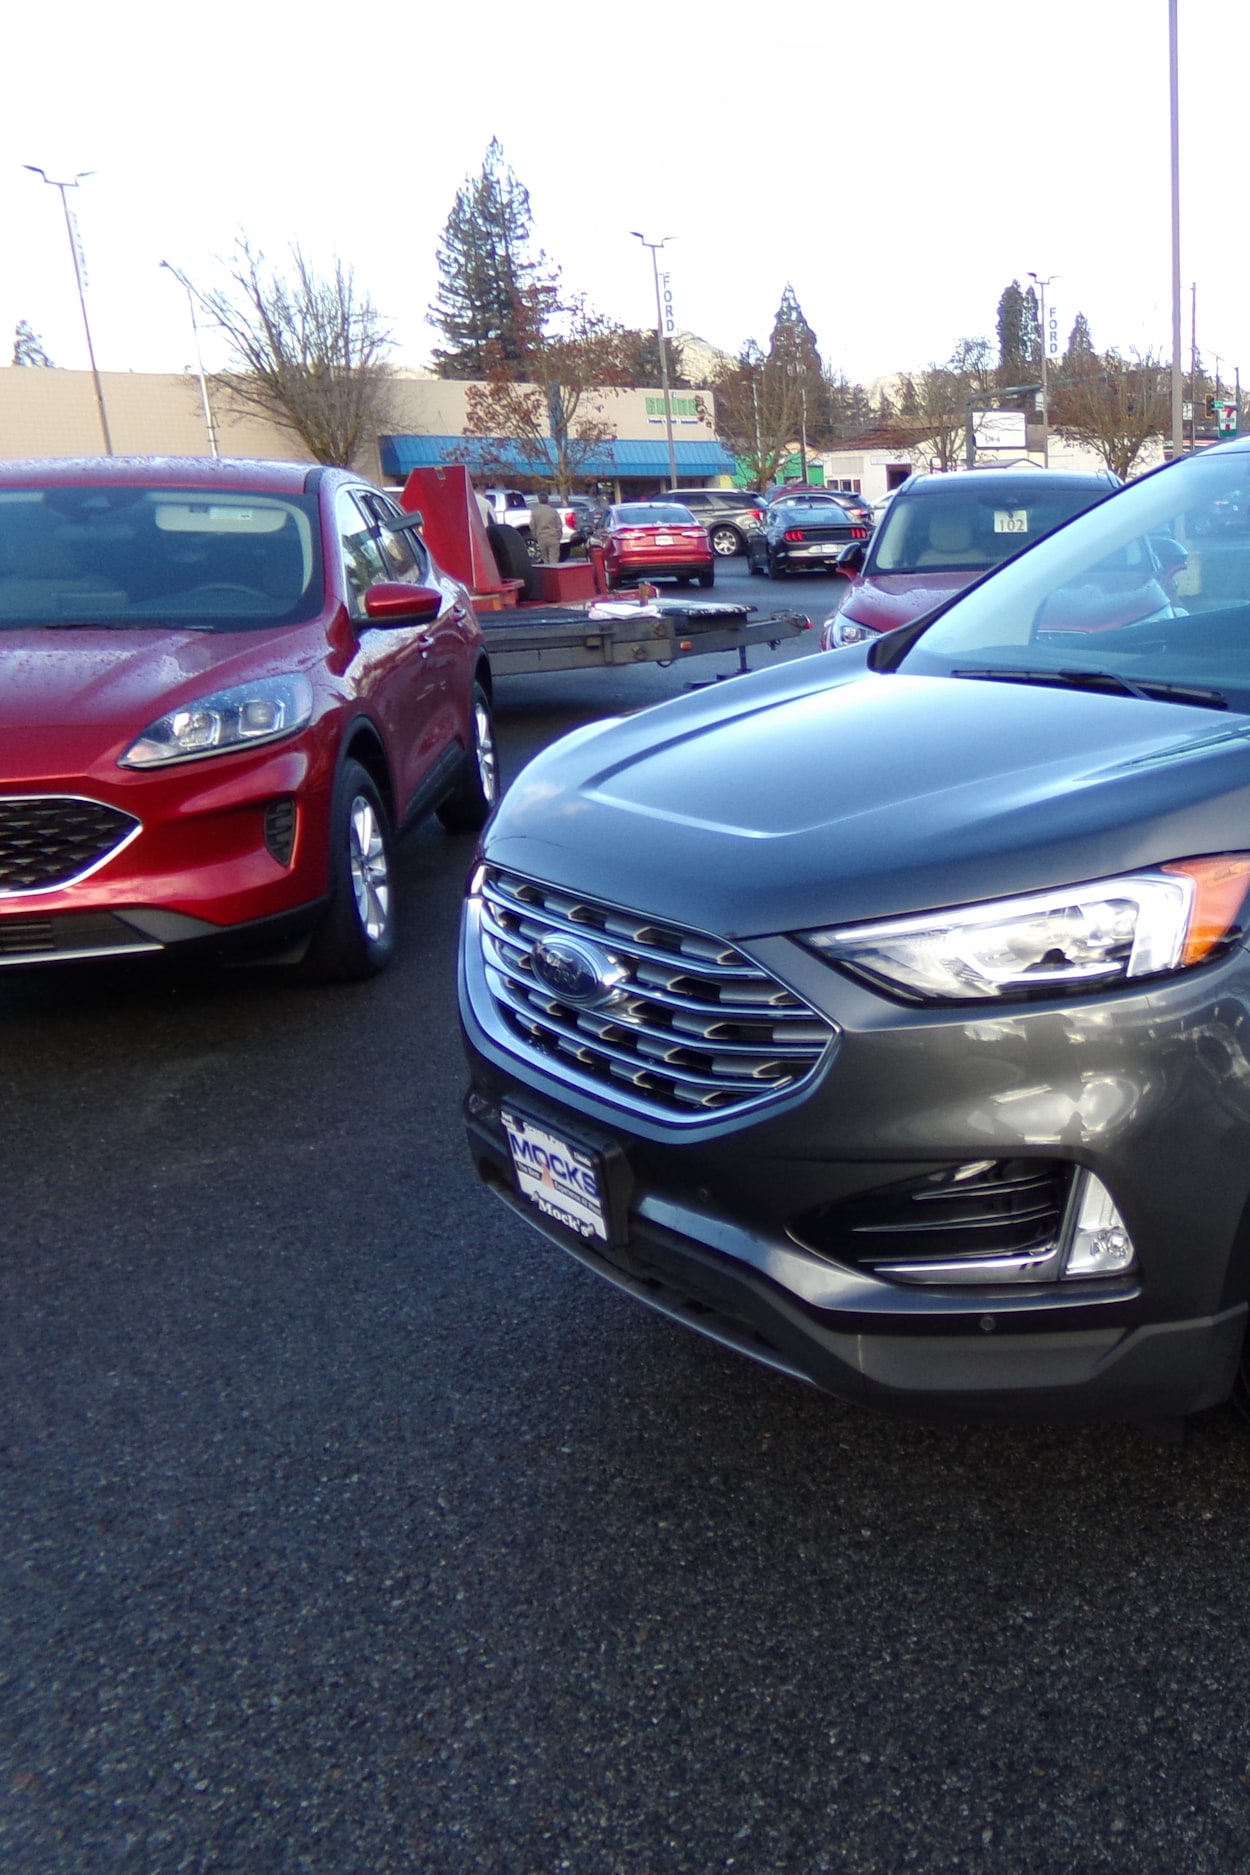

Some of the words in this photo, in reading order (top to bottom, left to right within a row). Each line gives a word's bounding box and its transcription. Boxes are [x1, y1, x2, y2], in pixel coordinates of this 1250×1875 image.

[663, 275, 675, 332] FORD
[1049, 307, 1058, 354] FORD
[1000, 519, 1025, 531] 102
[538, 1199, 590, 1237] Mock's
